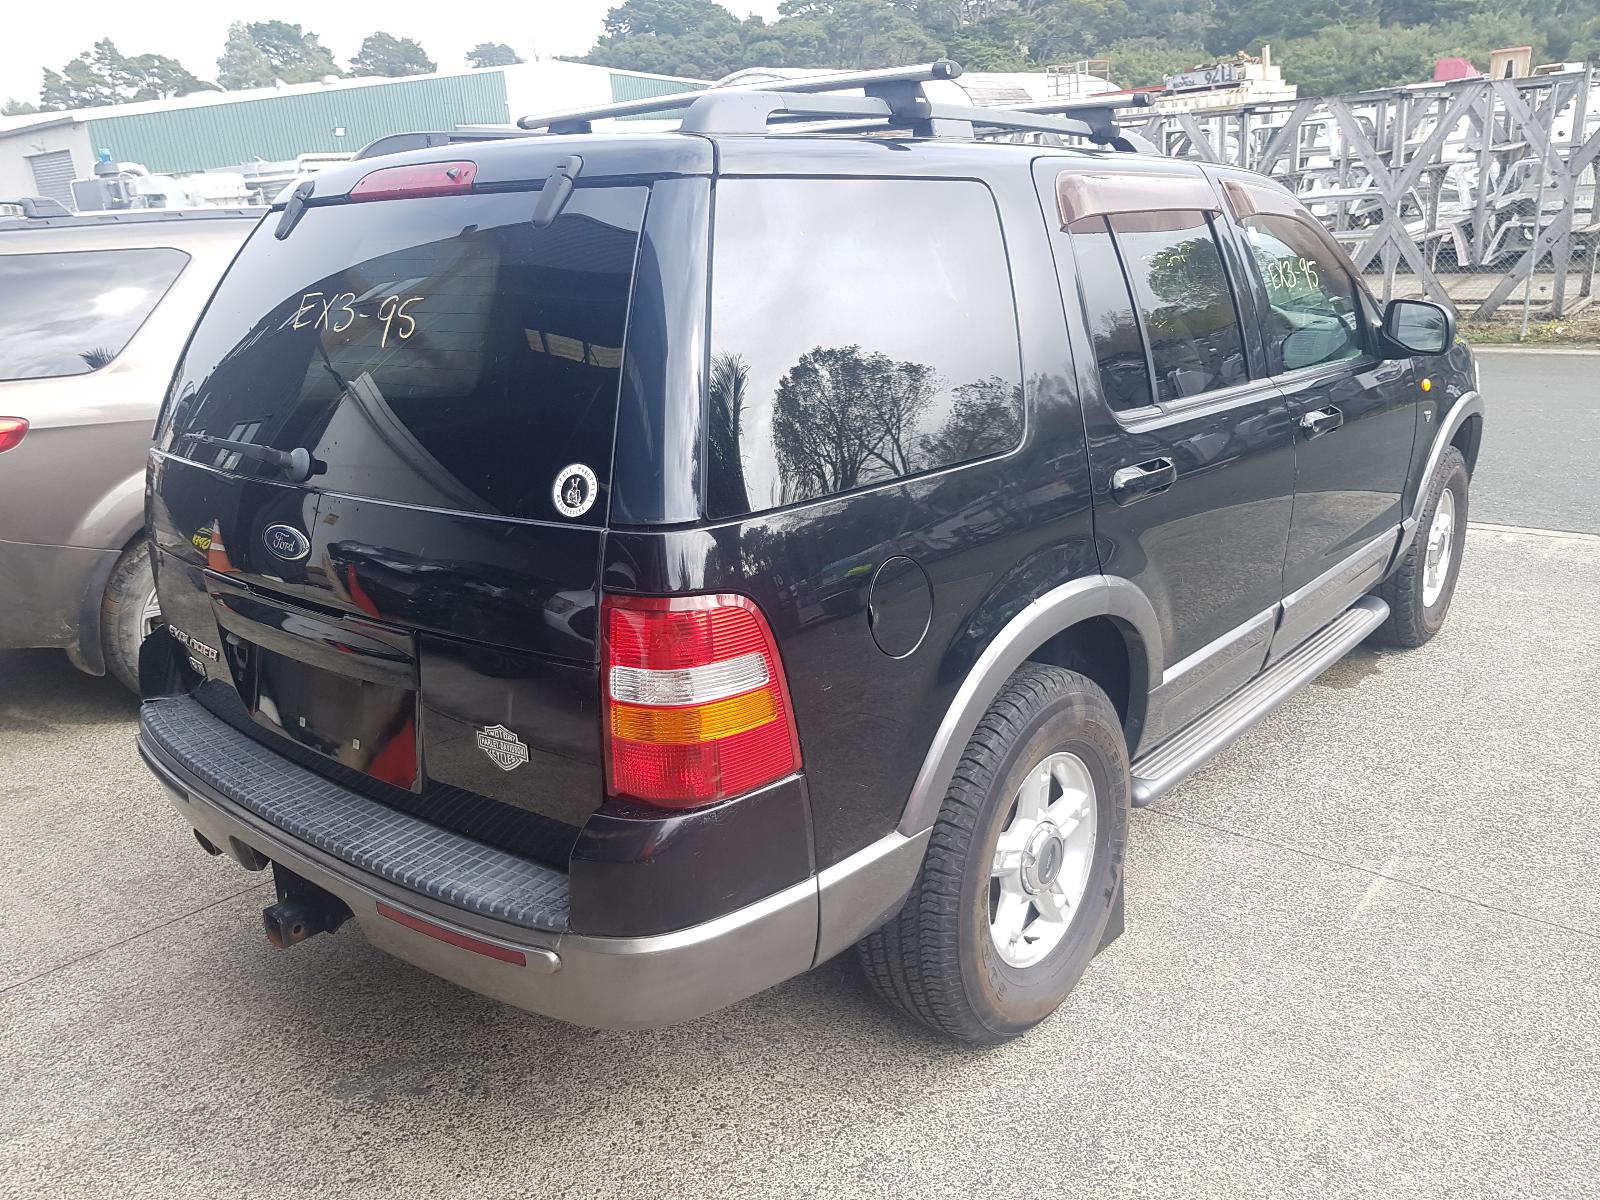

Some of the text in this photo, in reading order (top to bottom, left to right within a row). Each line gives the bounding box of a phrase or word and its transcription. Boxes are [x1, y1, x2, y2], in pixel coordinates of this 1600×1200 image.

[1267, 257, 1319, 291] EX3-95
[292, 292, 425, 348] EX3-95
[273, 531, 295, 552] Ford
